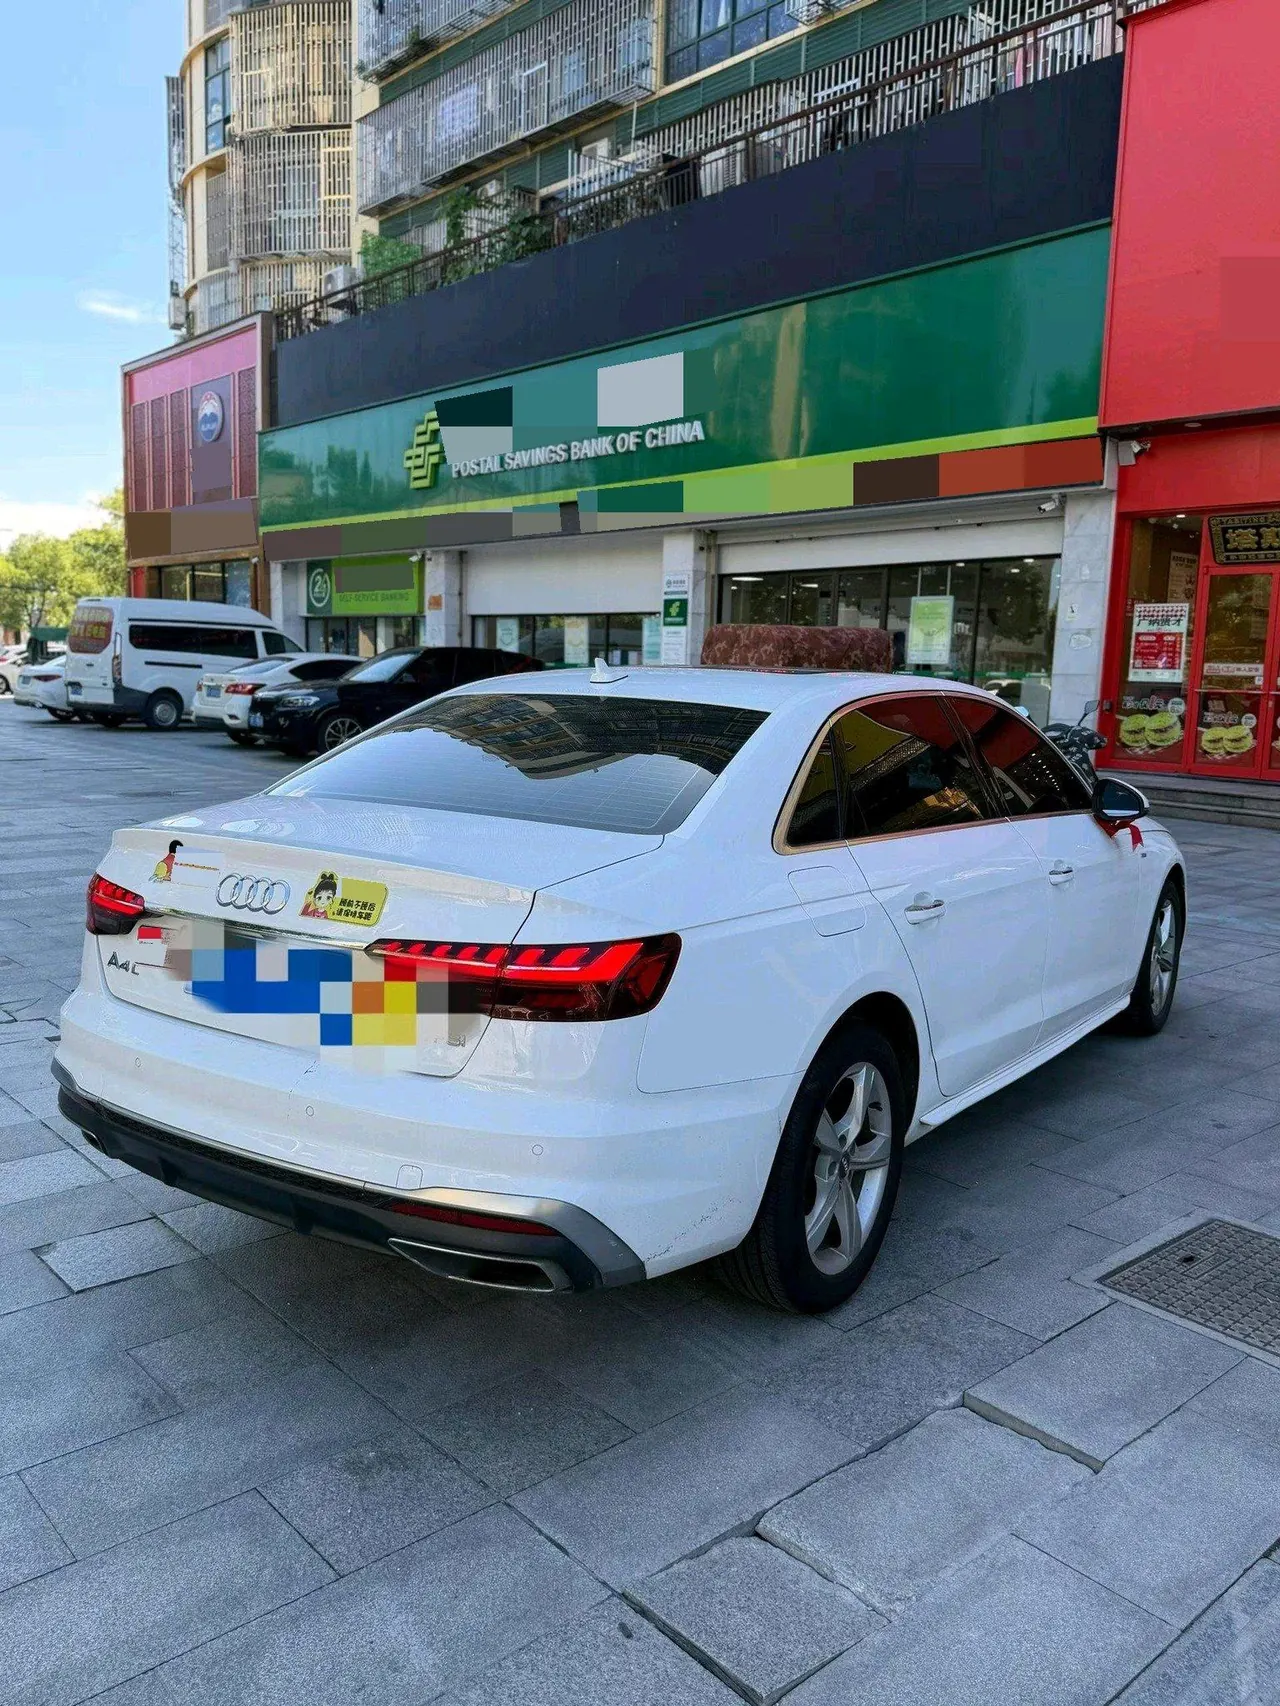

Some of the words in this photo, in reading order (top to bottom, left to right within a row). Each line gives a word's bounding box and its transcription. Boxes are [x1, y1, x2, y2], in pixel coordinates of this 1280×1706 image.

[452, 455, 504, 479] POSTAL
[504, 443, 569, 471] SAVINGS
[570, 435, 615, 461] BANK
[616, 431, 643, 453] OF
[644, 420, 705, 449] CHINA
[314, 575, 327, 592] 24
[336, 908, 373, 921] 请保持车距
[107, 951, 140, 976] A4L
